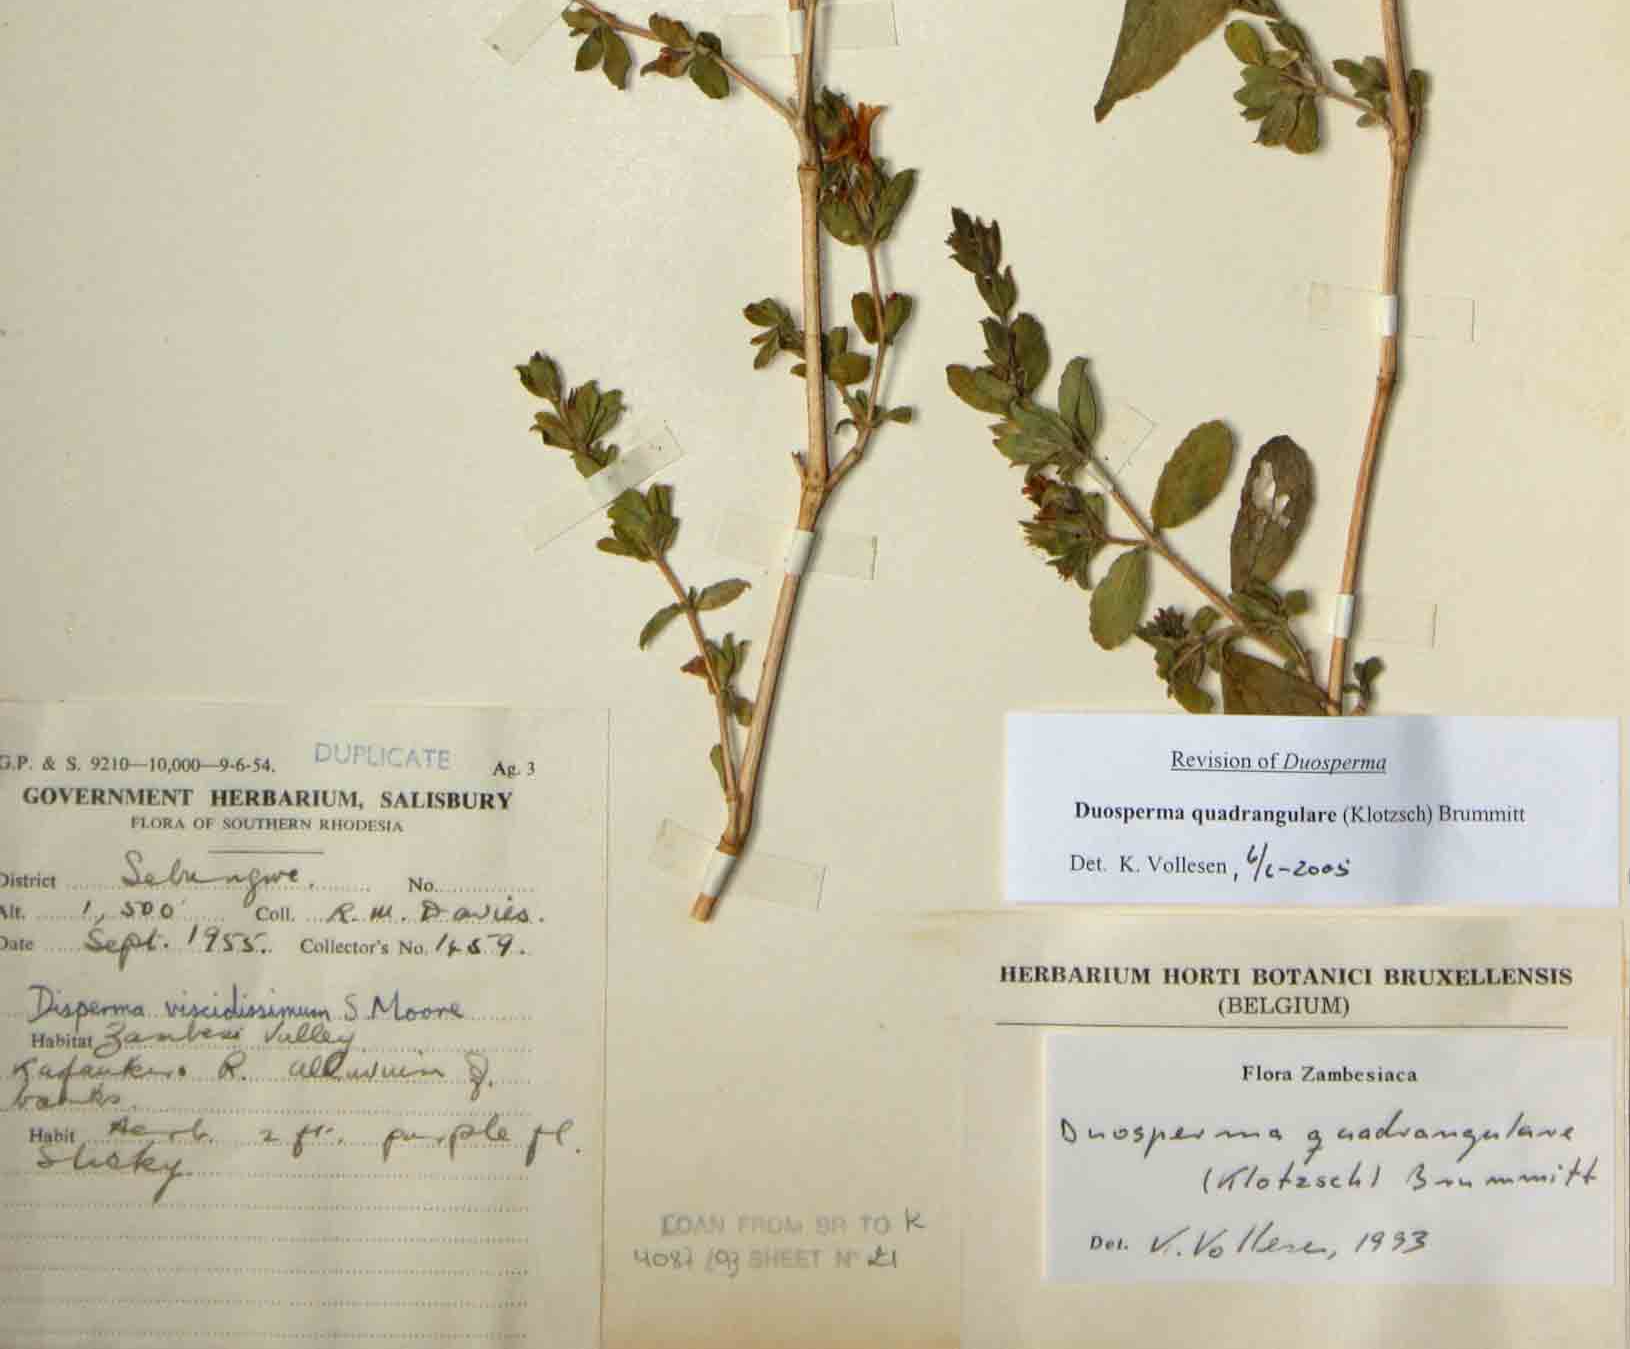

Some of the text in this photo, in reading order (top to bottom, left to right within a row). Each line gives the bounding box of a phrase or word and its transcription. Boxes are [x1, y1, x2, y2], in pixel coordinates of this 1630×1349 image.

[42, 756, 56, 771] &
[66, 756, 80, 772] S.
[314, 742, 450, 770] DUPLICATE
[1171, 750, 1387, 774] Revision of Duosperma
[527, 761, 536, 776] 3
[23, 786, 513, 810] GOVERNMENT HERBARIUM, SALISBURY
[1074, 802, 1526, 826] Duosperma quadrangulare (Klotzsch) Brummitt
[131, 816, 404, 832] FLORA OF SOUTHERN RHODESIA
[1070, 854, 1106, 873] Det.
[1119, 856, 1140, 873] K.
[255, 907, 295, 923] Coll.
[301, 937, 388, 955] Collector's
[1000, 965, 1574, 986] HERBARIUM HORTI BOTANICI BRUXELLENSIS
[1218, 996, 1350, 1018] (BELGIUM)
[31, 1033, 94, 1049] Habitat
[1241, 1065, 1418, 1083] Flora Zambesiaca
[29, 1127, 75, 1143] Habit
[858, 1214, 892, 1235] TO
[1090, 1236, 1129, 1251] Det.
[749, 1249, 822, 1269] SHEET
